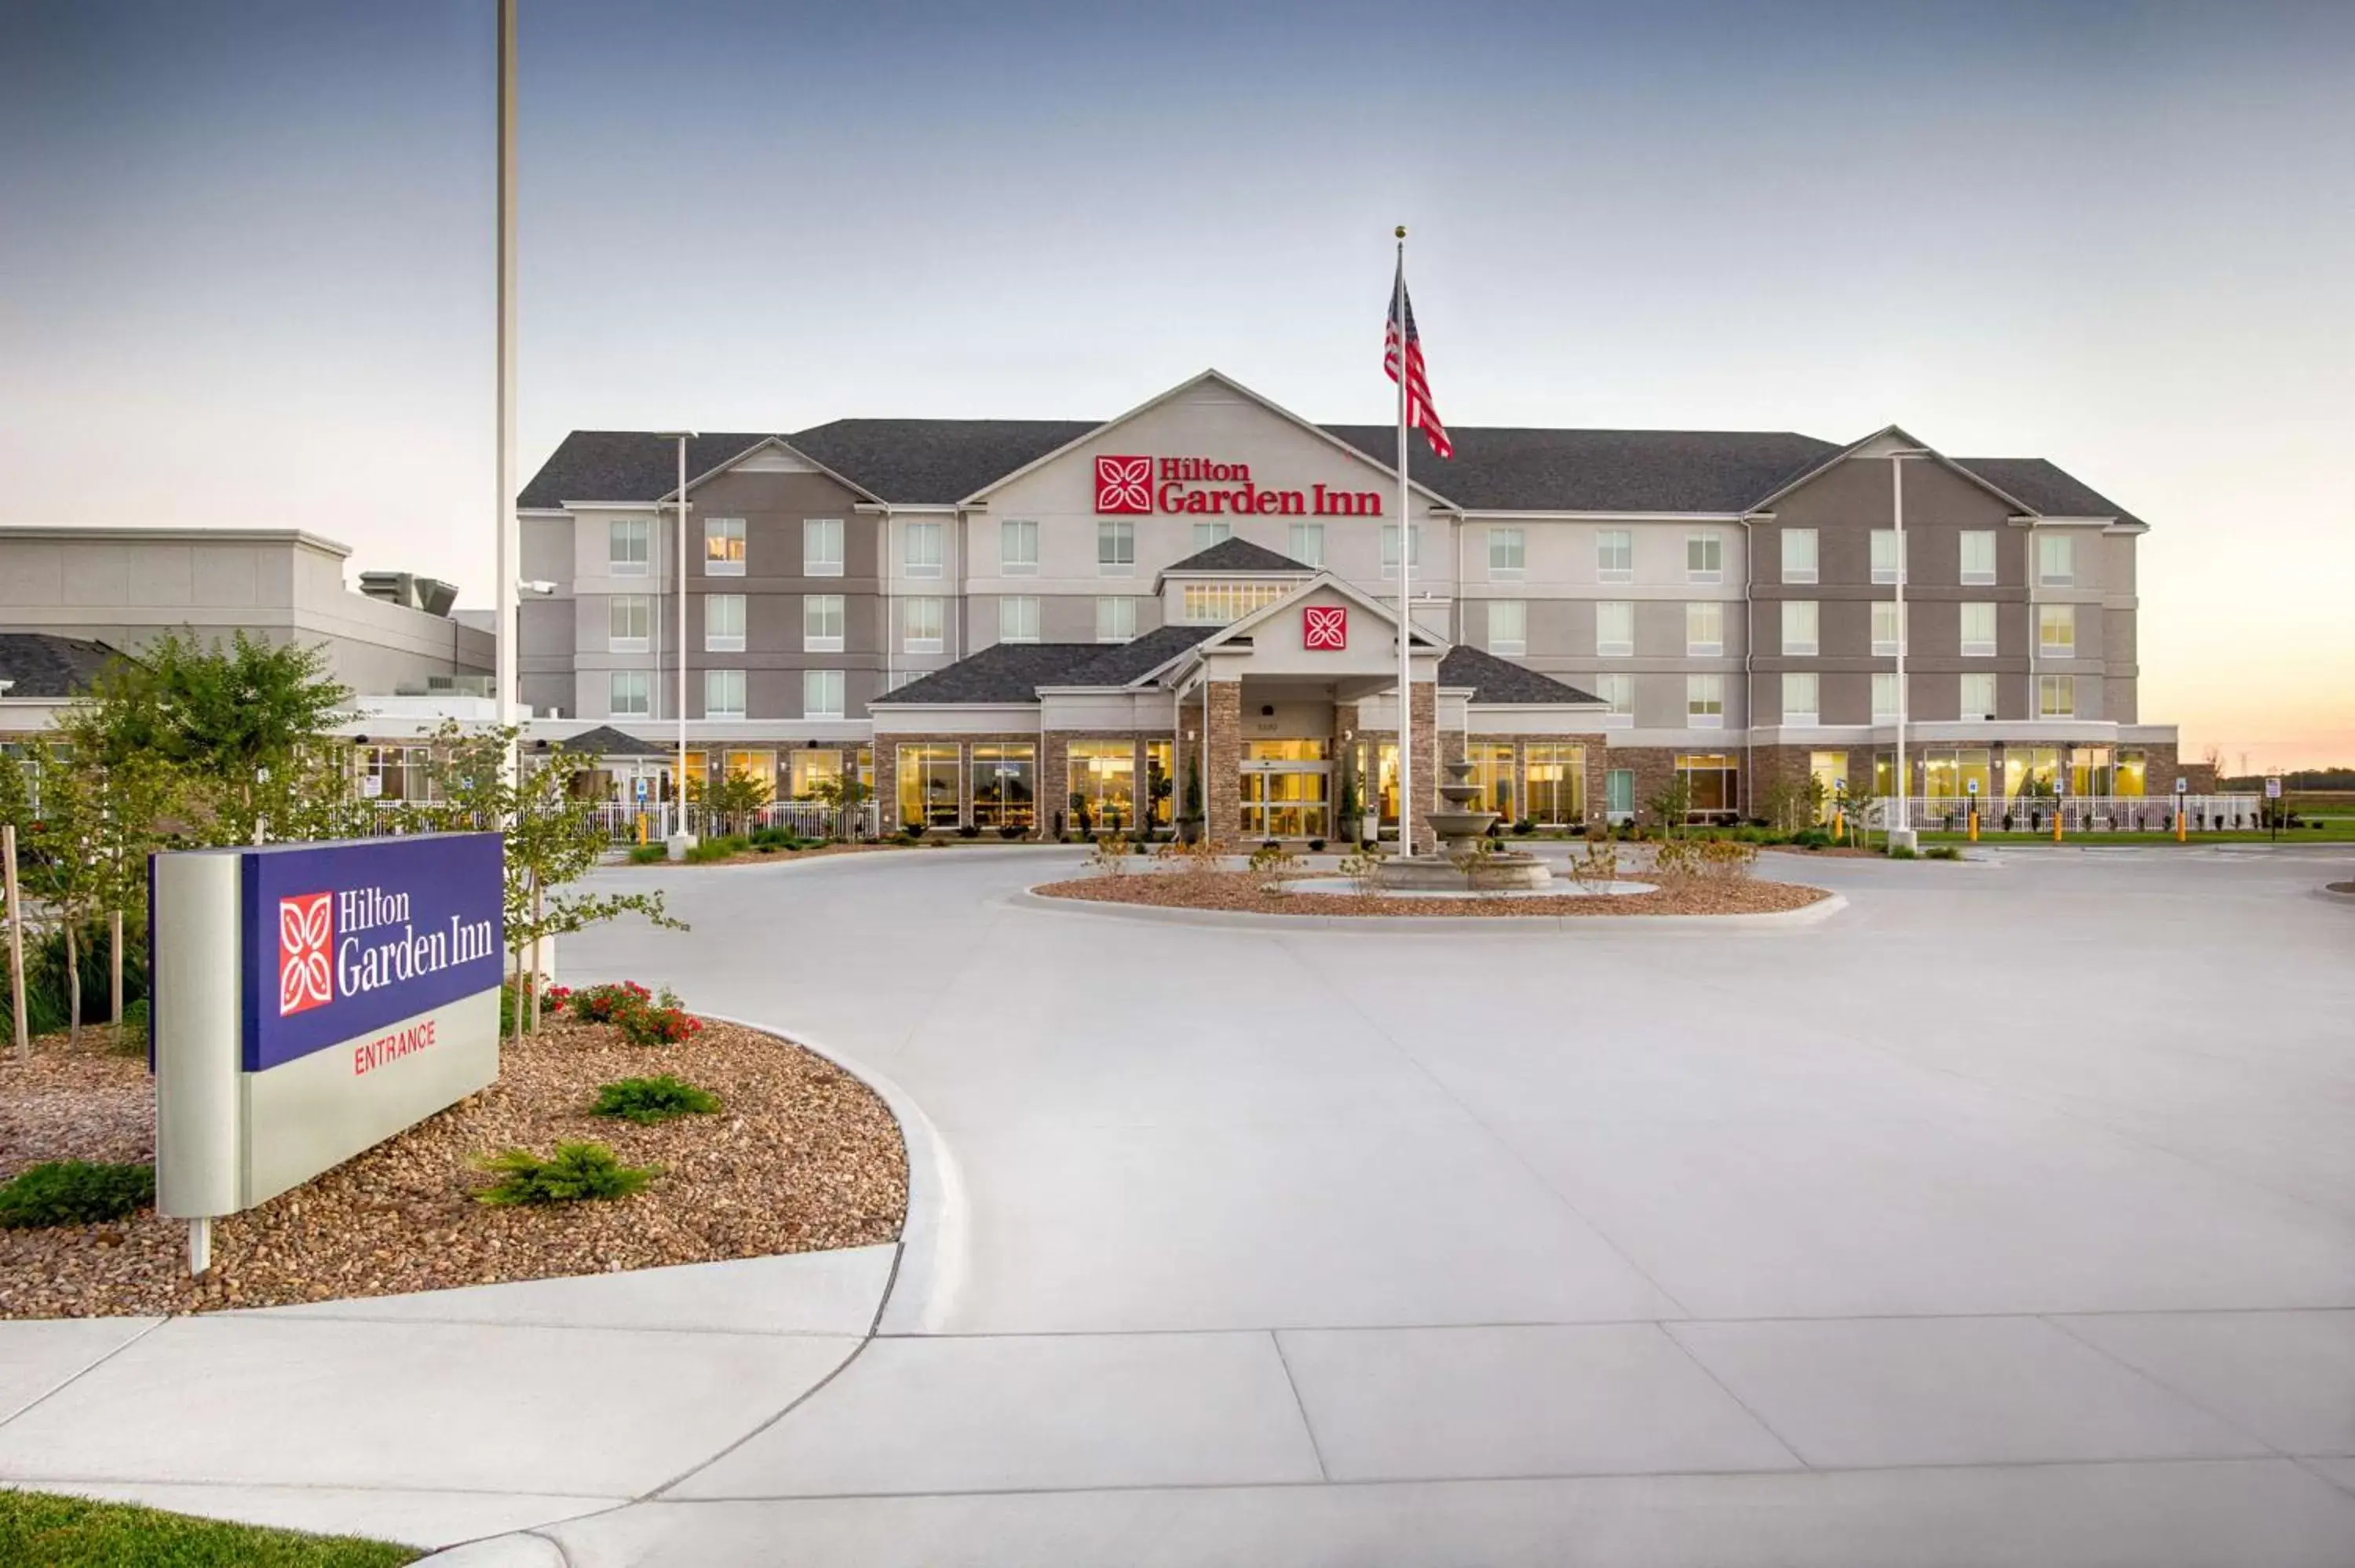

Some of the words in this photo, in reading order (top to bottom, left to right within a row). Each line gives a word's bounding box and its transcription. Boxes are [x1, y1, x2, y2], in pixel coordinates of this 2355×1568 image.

[1158, 458, 1251, 481] Hilton
[1158, 483, 1306, 515] Garden
[1312, 483, 1382, 516] Inn
[338, 887, 410, 933] Hilton
[338, 924, 447, 997] Garden
[451, 915, 493, 966] Inn
[354, 1020, 436, 1075] ENTRANCE
